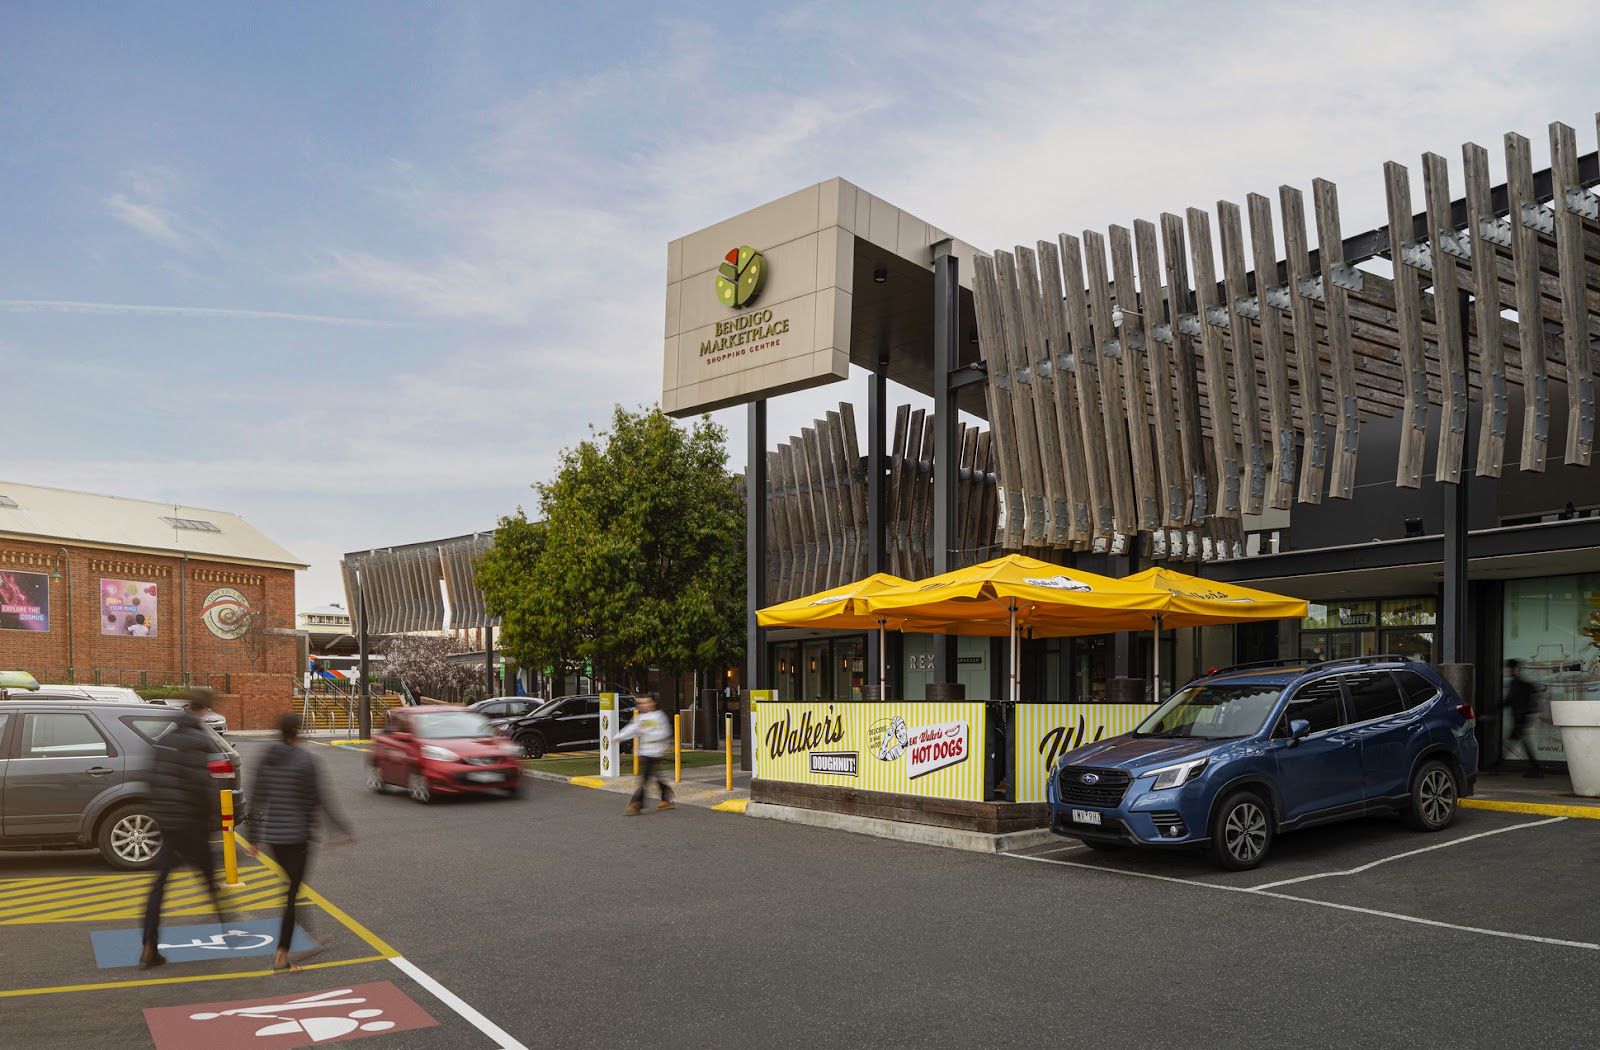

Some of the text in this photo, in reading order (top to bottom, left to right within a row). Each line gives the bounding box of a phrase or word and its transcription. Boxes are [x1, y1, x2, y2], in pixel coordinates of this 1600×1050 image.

[715, 309, 773, 337] BENDIGO
[699, 319, 789, 356] MARKETPLACE
[706, 339, 781, 365] SHOPPING CENTRE
[207, 589, 246, 604] DISCOVERY
[20, 613, 43, 621] COSMOS
[1342, 615, 1368, 625] COFFEE
[909, 654, 935, 669] REX
[765, 704, 845, 760] Walker's
[869, 725, 887, 736] DELICIOUS
[909, 736, 918, 747] EAT
[911, 737, 963, 765] HOT DOGS
